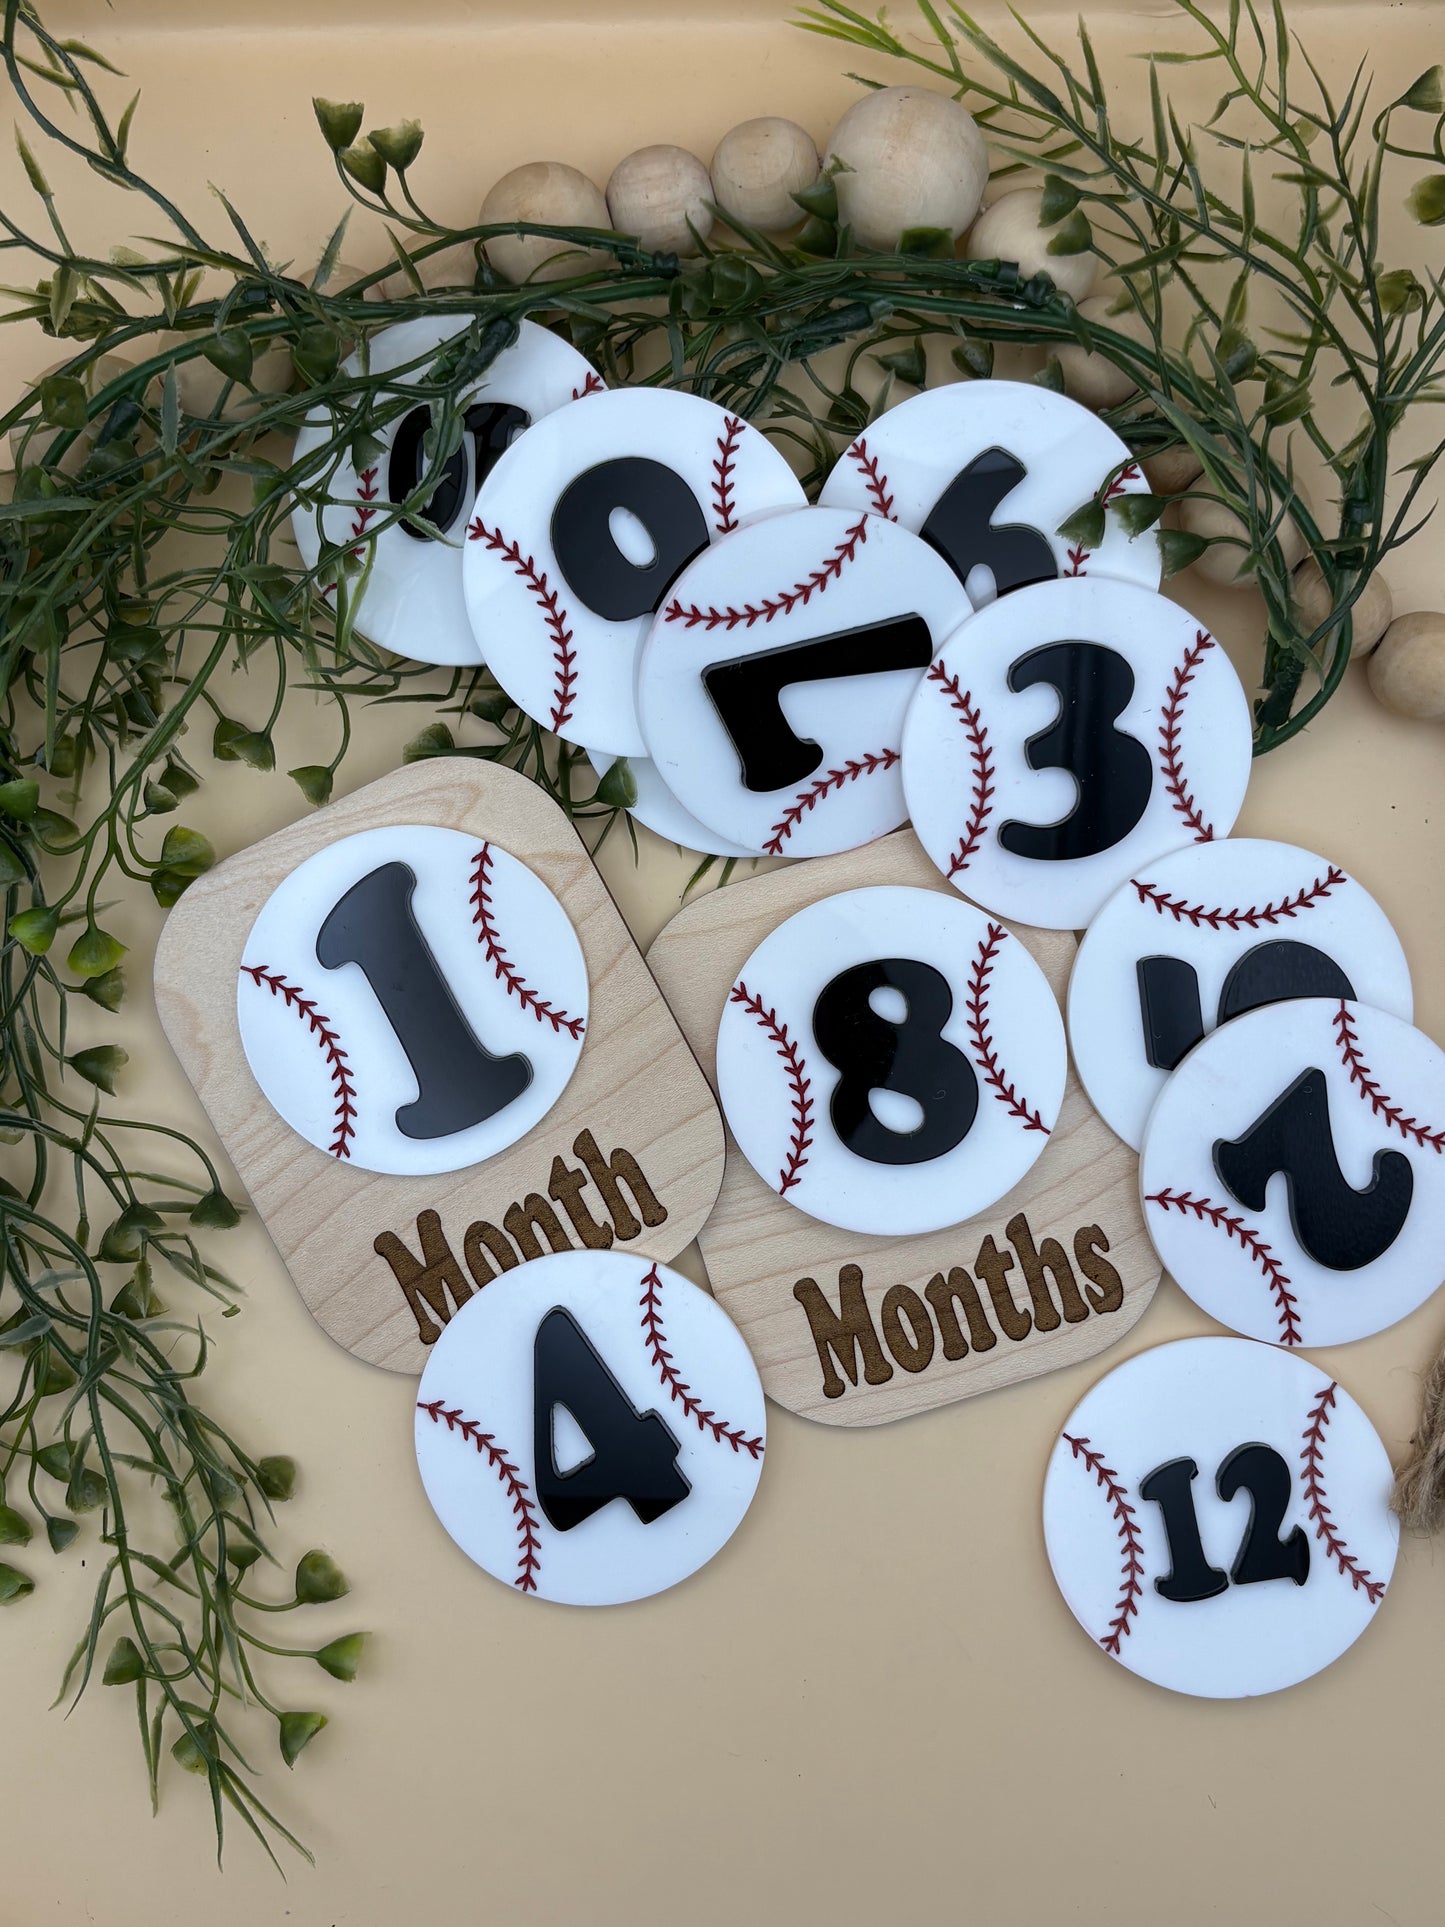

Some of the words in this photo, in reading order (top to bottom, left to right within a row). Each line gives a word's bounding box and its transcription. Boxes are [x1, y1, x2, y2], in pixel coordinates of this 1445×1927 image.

[701, 612, 933, 792] 7
[998, 639, 1153, 862] 3
[315, 861, 535, 1140] 1
[812, 958, 979, 1165] 8
[373, 1127, 668, 1346] Month
[1212, 1067, 1414, 1272] 2
[793, 1213, 1124, 1400] Months
[533, 1304, 693, 1532] 4
[1139, 1441, 1311, 1603] 12
